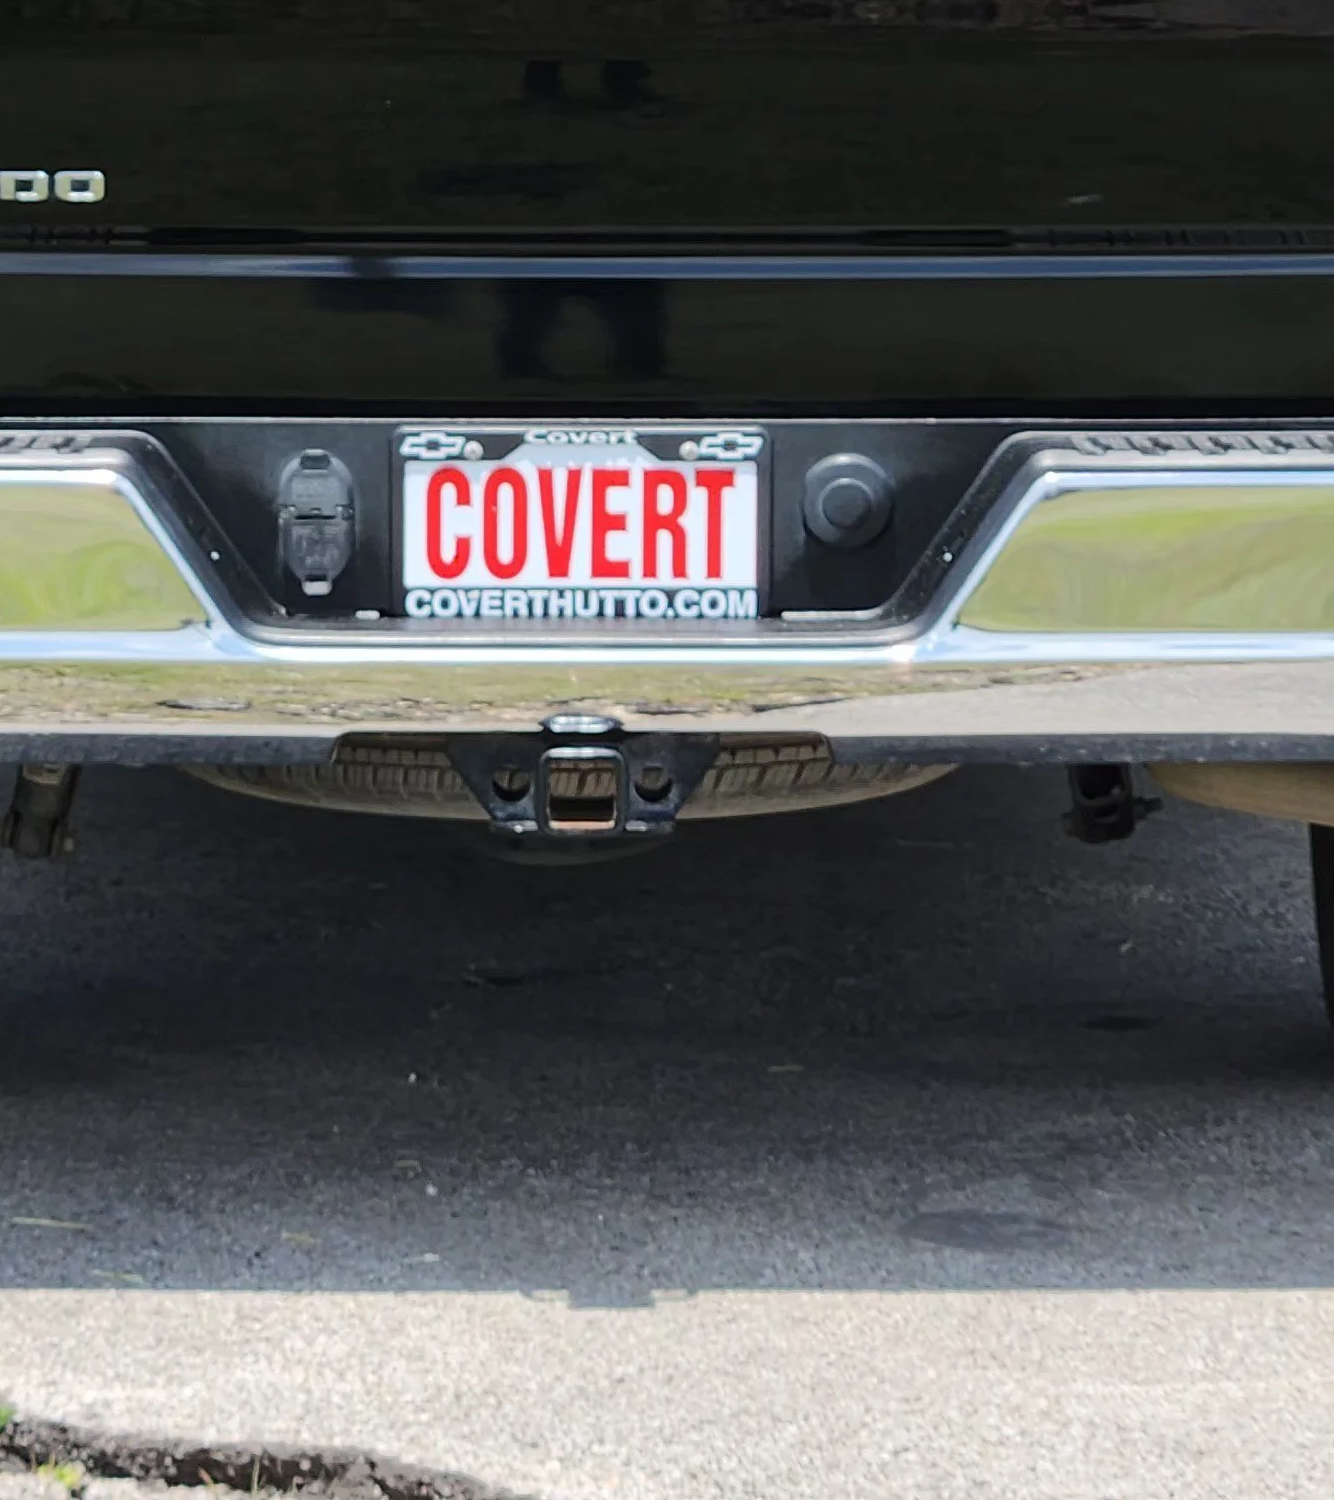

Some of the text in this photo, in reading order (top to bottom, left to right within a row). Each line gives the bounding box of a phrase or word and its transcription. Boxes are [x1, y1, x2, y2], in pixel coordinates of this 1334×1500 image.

[524, 429, 638, 445] Covert
[426, 467, 736, 579] COVERT
[405, 590, 758, 618] COVERTHUTTO.COM
